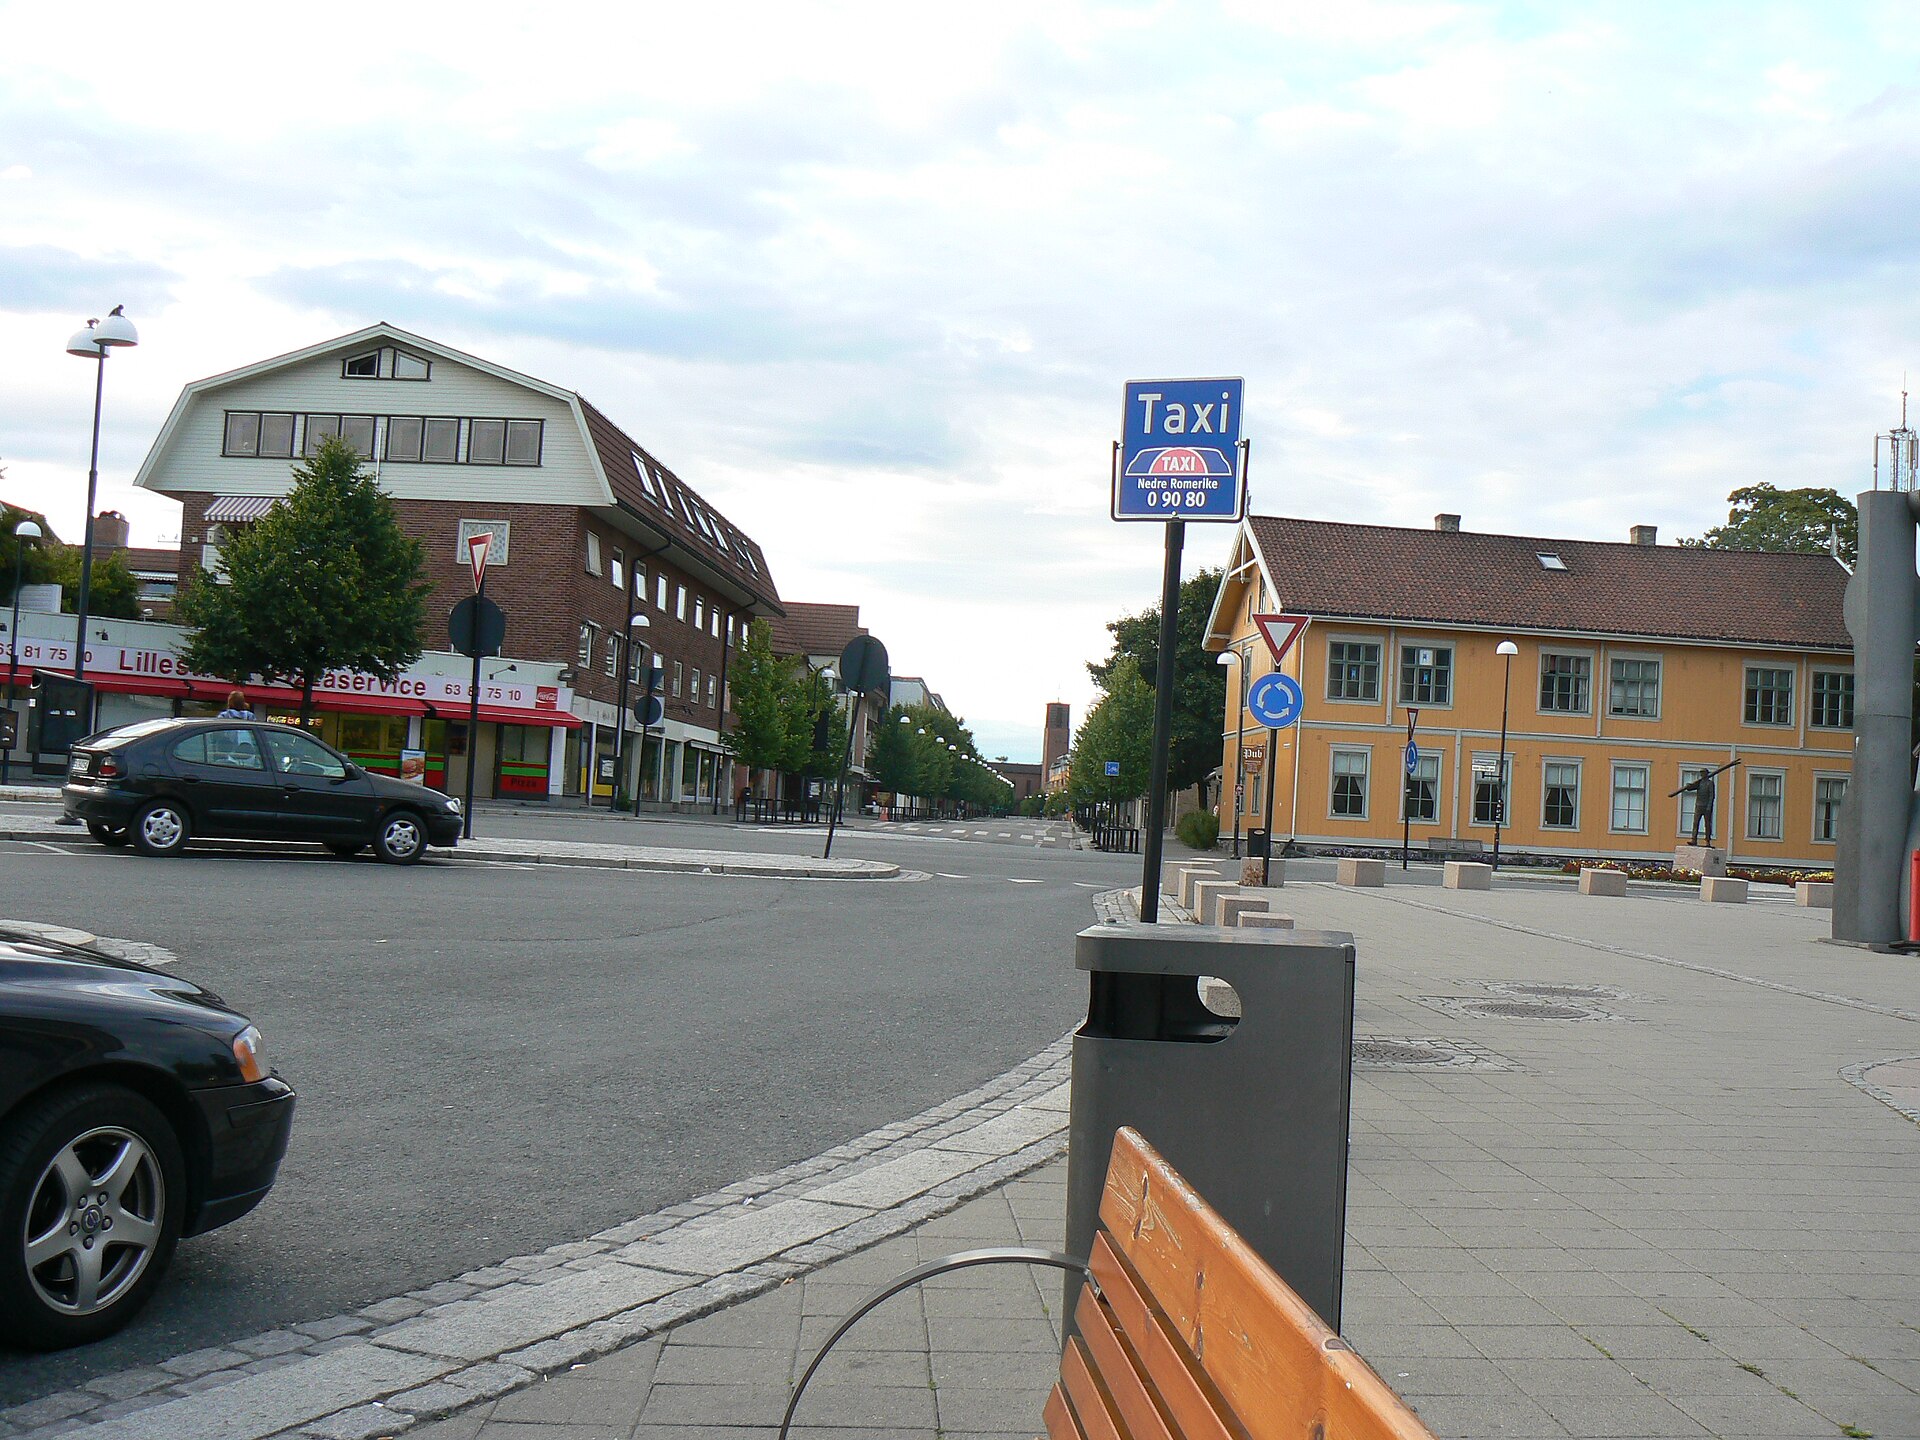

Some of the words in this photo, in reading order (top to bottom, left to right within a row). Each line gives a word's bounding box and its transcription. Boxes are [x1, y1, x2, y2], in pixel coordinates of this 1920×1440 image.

[1137, 391, 1229, 434] Taxi
[1161, 456, 1196, 471] TAXI
[1137, 478, 1167, 489] Nedre
[1170, 478, 1218, 489] Romerike
[1147, 491, 1157, 507] 0
[1161, 491, 1181, 508] 90
[1185, 491, 1205, 507] 80
[24, 645, 41, 659] 81
[49, 647, 68, 661] 75
[445, 683, 462, 696] 63
[487, 687, 502, 699] 75
[508, 689, 522, 701] 10
[1243, 748, 1263, 760] Pub
